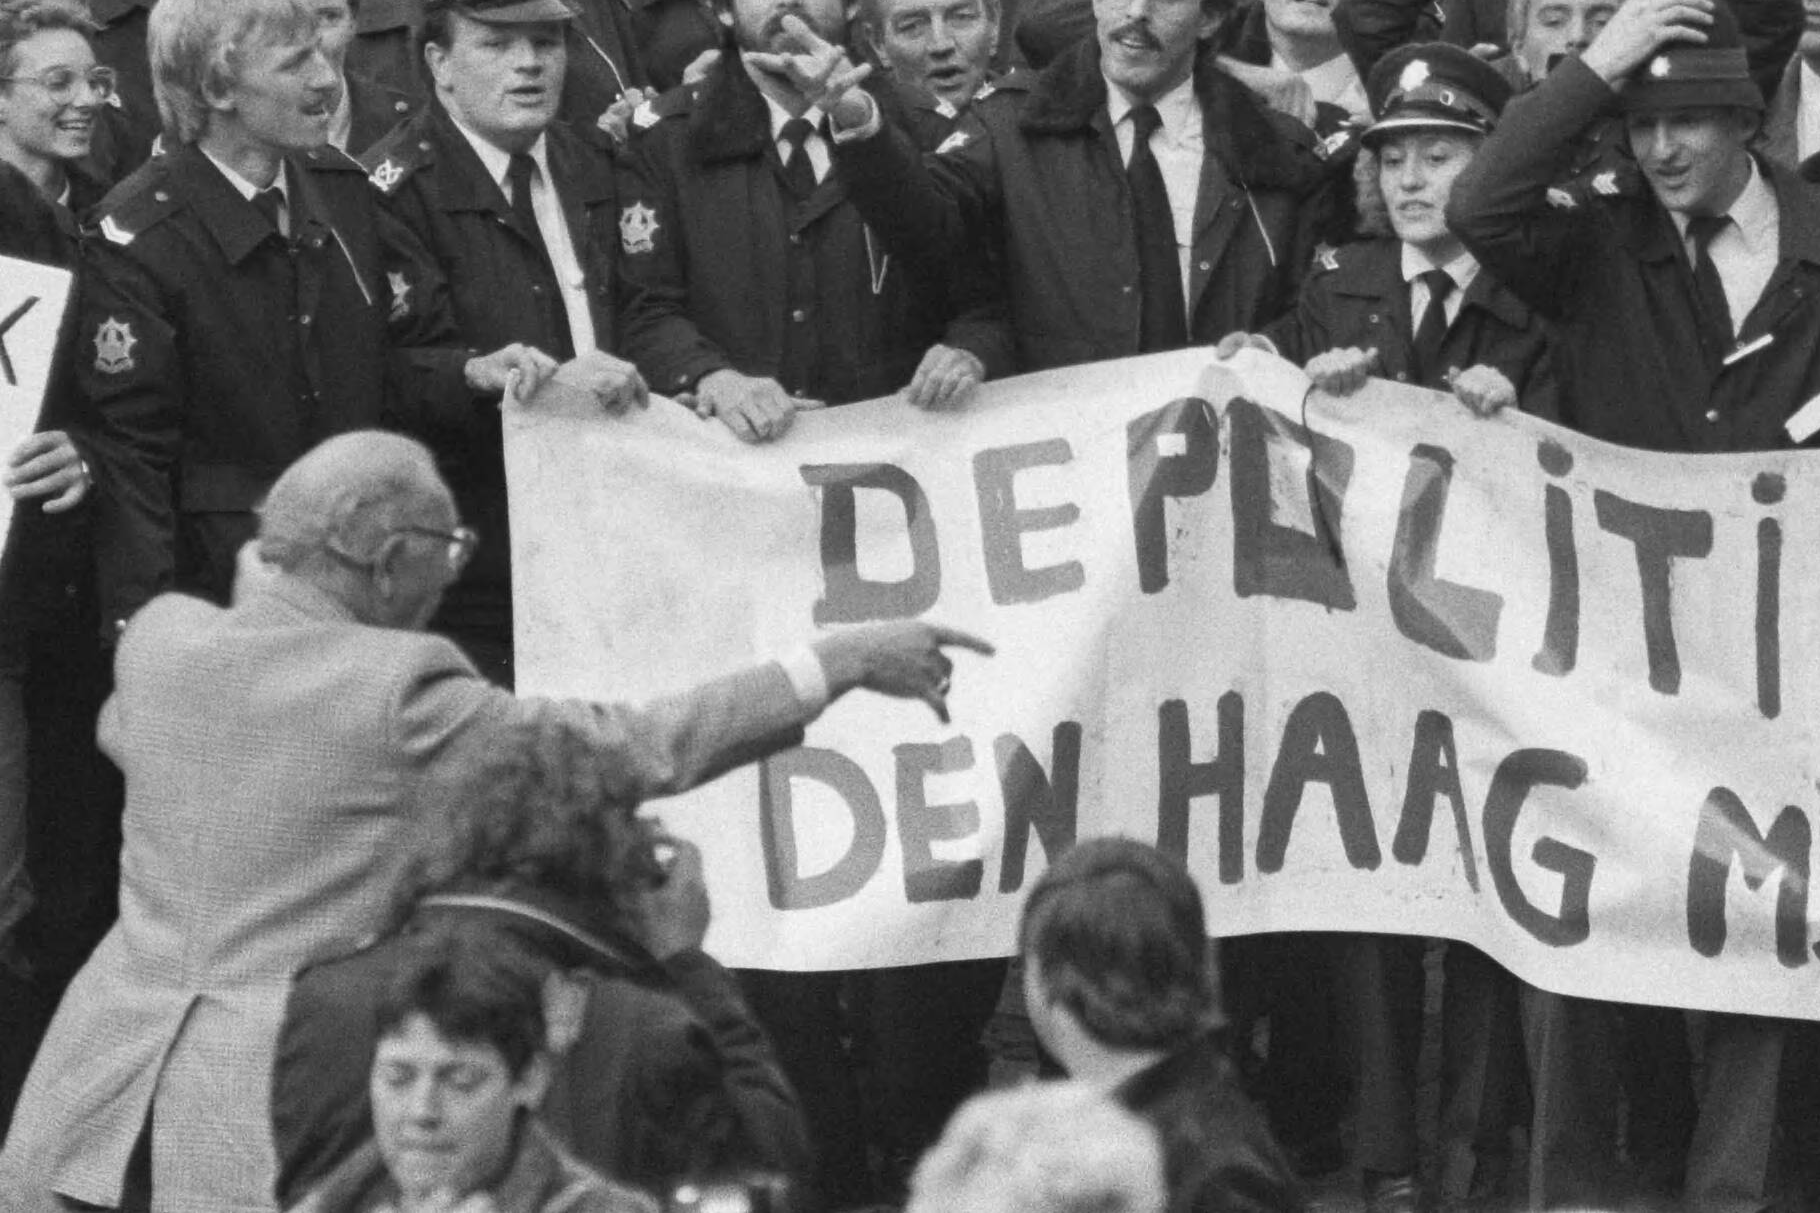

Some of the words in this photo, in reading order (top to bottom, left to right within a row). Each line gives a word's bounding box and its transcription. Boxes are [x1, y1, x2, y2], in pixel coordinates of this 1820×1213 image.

[800, 437, 1086, 626] DE
[757, 721, 1083, 911] DEN
[1157, 689, 1597, 948] HAAG
